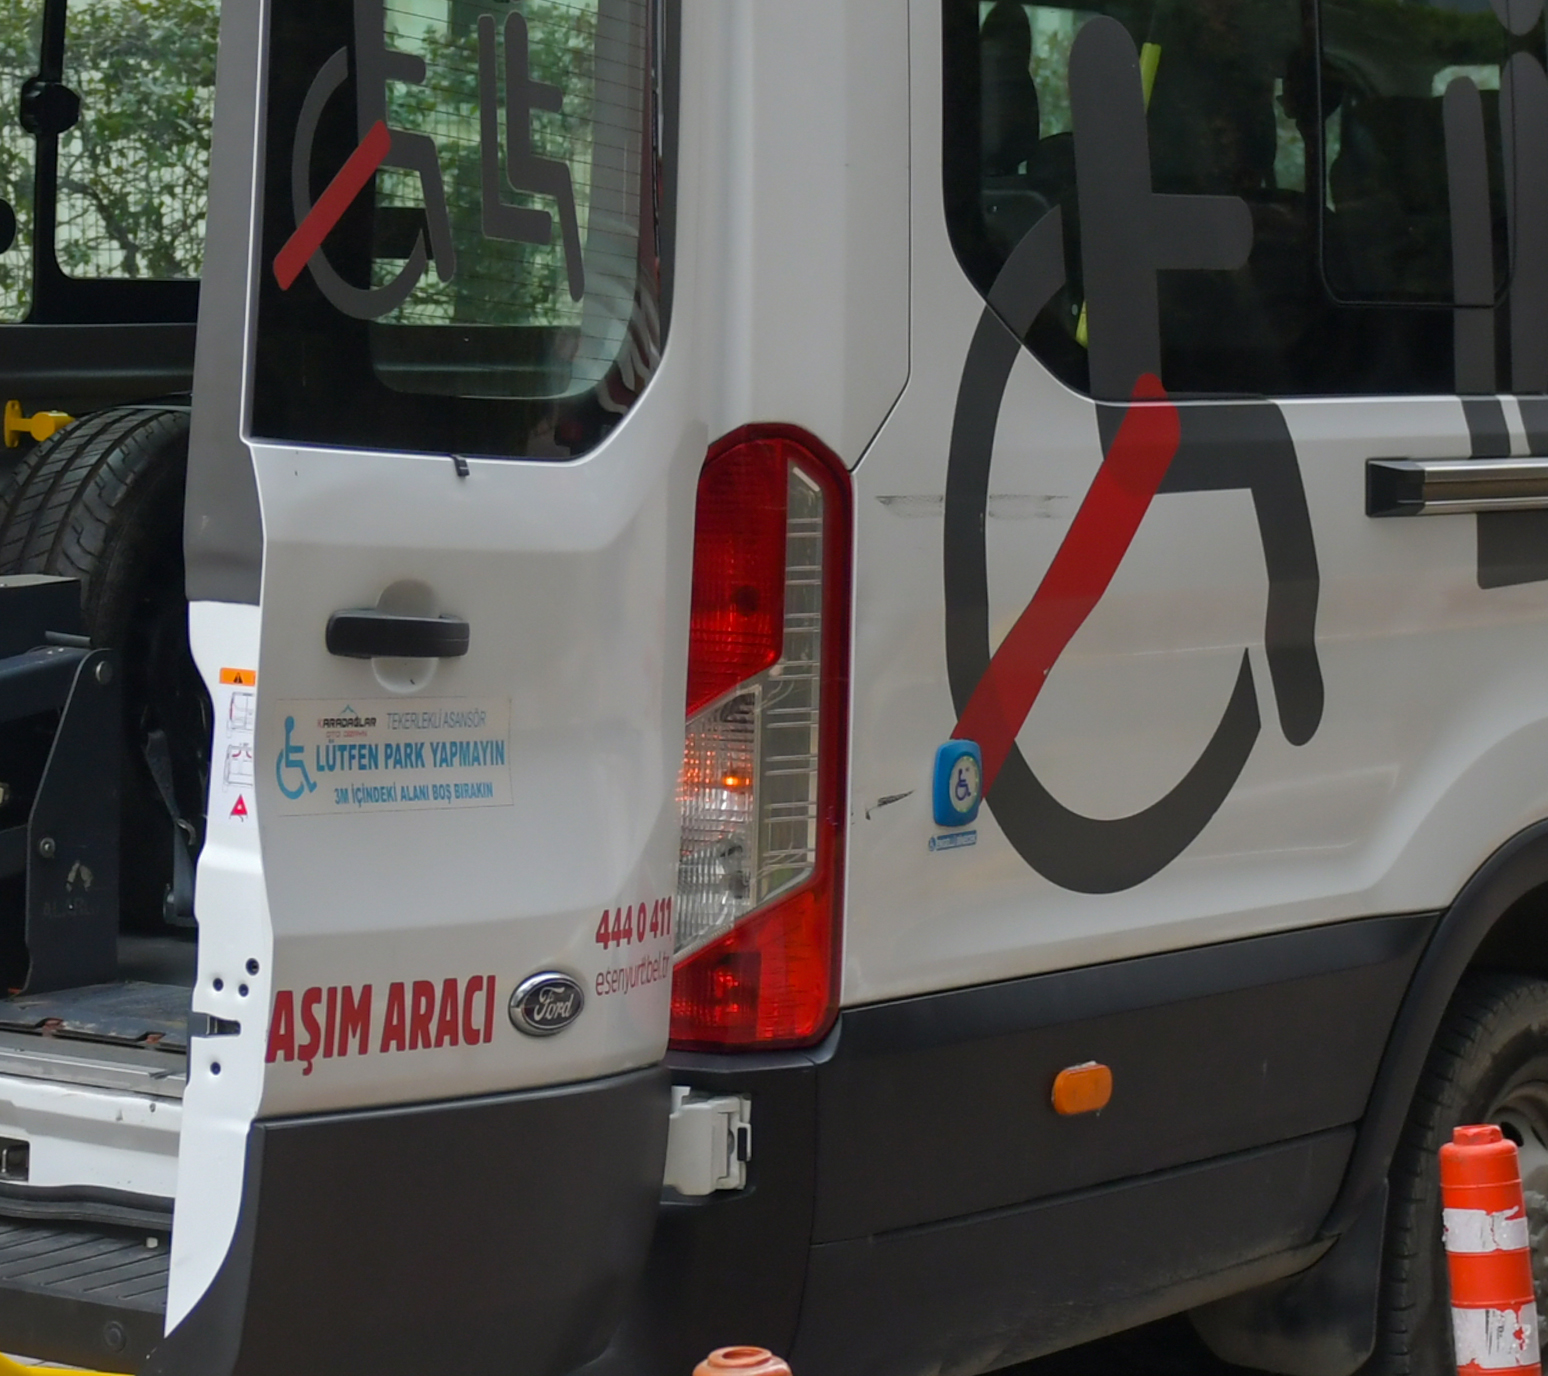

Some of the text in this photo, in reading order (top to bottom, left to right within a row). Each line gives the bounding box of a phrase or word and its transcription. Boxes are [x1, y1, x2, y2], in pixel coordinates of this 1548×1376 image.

[387, 707, 487, 730] TEKERLEKLİ ASANSÖR
[315, 738, 506, 773] LÜTFEN PARK YAPMAYIN
[333, 782, 494, 808] 3M İÇİNDEKİ ALANI BOŞ BIRAKIN
[595, 896, 672, 950] 444 0 411
[595, 952, 671, 996] esenyurt.bel.tr
[380, 973, 498, 1055] ARACI
[532, 985, 575, 1022] Ford
